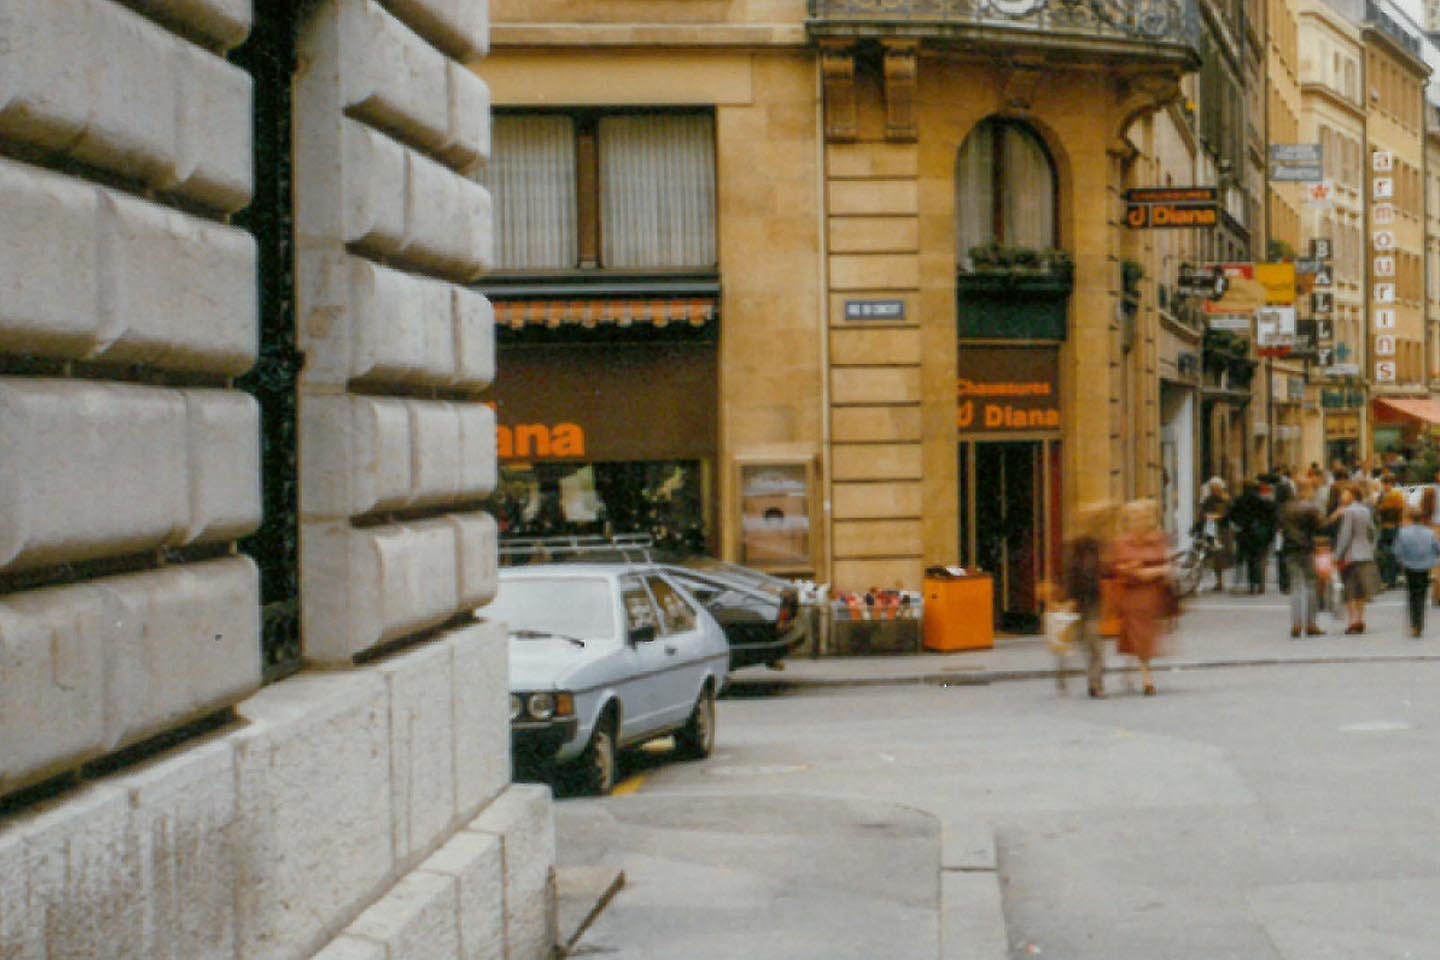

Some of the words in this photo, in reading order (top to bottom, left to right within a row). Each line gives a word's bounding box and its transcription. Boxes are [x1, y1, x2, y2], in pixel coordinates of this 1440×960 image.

[1152, 204, 1216, 226] Diana
[1315, 240, 1331, 366] BALLY
[1373, 153, 1393, 378] armourins
[985, 403, 1060, 429] Diana
